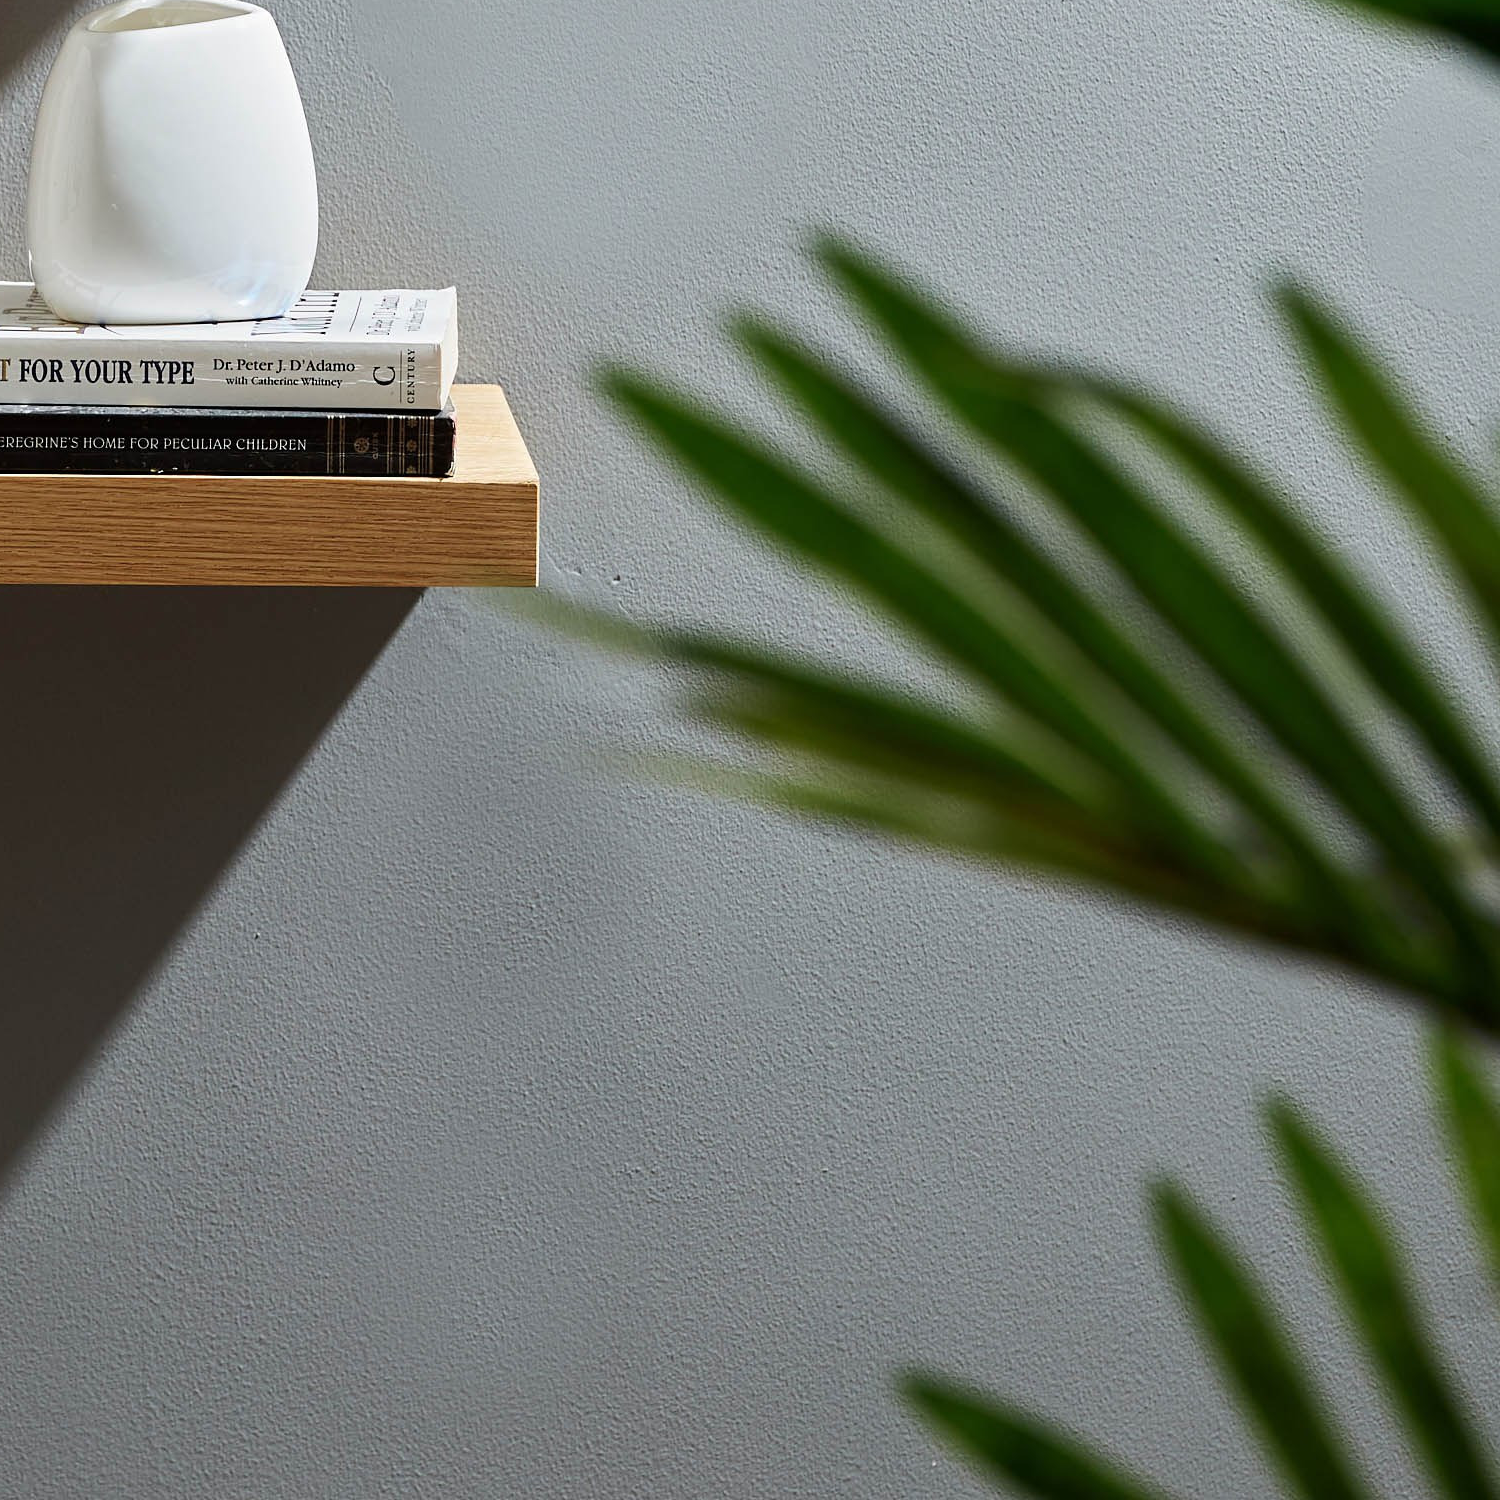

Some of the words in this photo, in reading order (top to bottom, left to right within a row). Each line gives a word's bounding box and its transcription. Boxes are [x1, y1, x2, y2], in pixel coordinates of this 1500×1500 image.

[19, 358, 64, 383] FOR
[71, 359, 133, 384] YOUR
[139, 359, 195, 385] TYPE
[213, 358, 233, 371] Dr.
[237, 358, 273, 372] Peter
[276, 359, 286, 374] J.
[290, 360, 356, 373] D'Adamo
[225, 376, 248, 386] with
[251, 376, 298, 386] Catherine
[300, 377, 343, 389] Whitney
[407, 348, 416, 404] CENTURY
[83, 436, 125, 450] HOME
[130, 437, 159, 450] FOR
[164, 437, 231, 451] PECULIAR
[236, 438, 307, 451] CHILDREN
